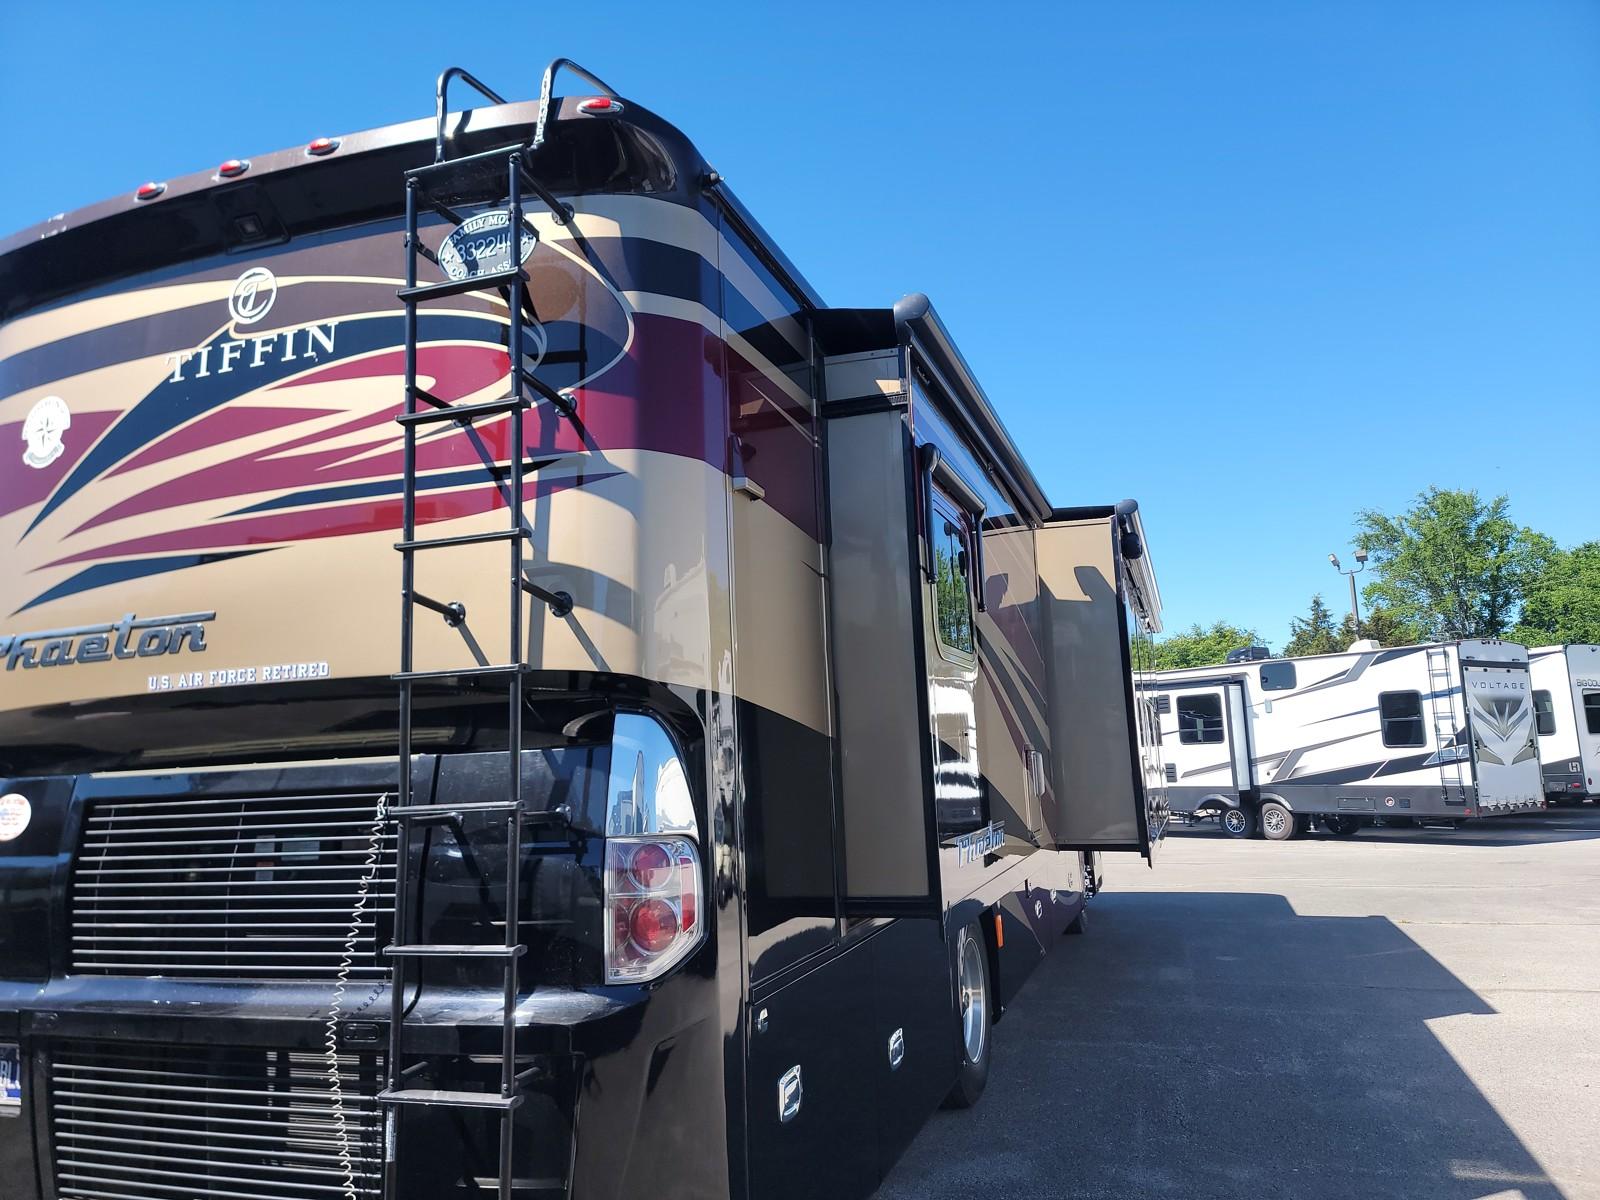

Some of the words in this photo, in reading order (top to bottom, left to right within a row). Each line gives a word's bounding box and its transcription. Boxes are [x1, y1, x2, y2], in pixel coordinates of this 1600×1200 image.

[166, 321, 339, 383] TIFFIN
[148, 674, 174, 690] U.S.
[177, 672, 204, 688] AIR
[209, 667, 257, 686] FORCE
[261, 662, 329, 681] RETIRED
[1471, 681, 1525, 690] VOLTAGE
